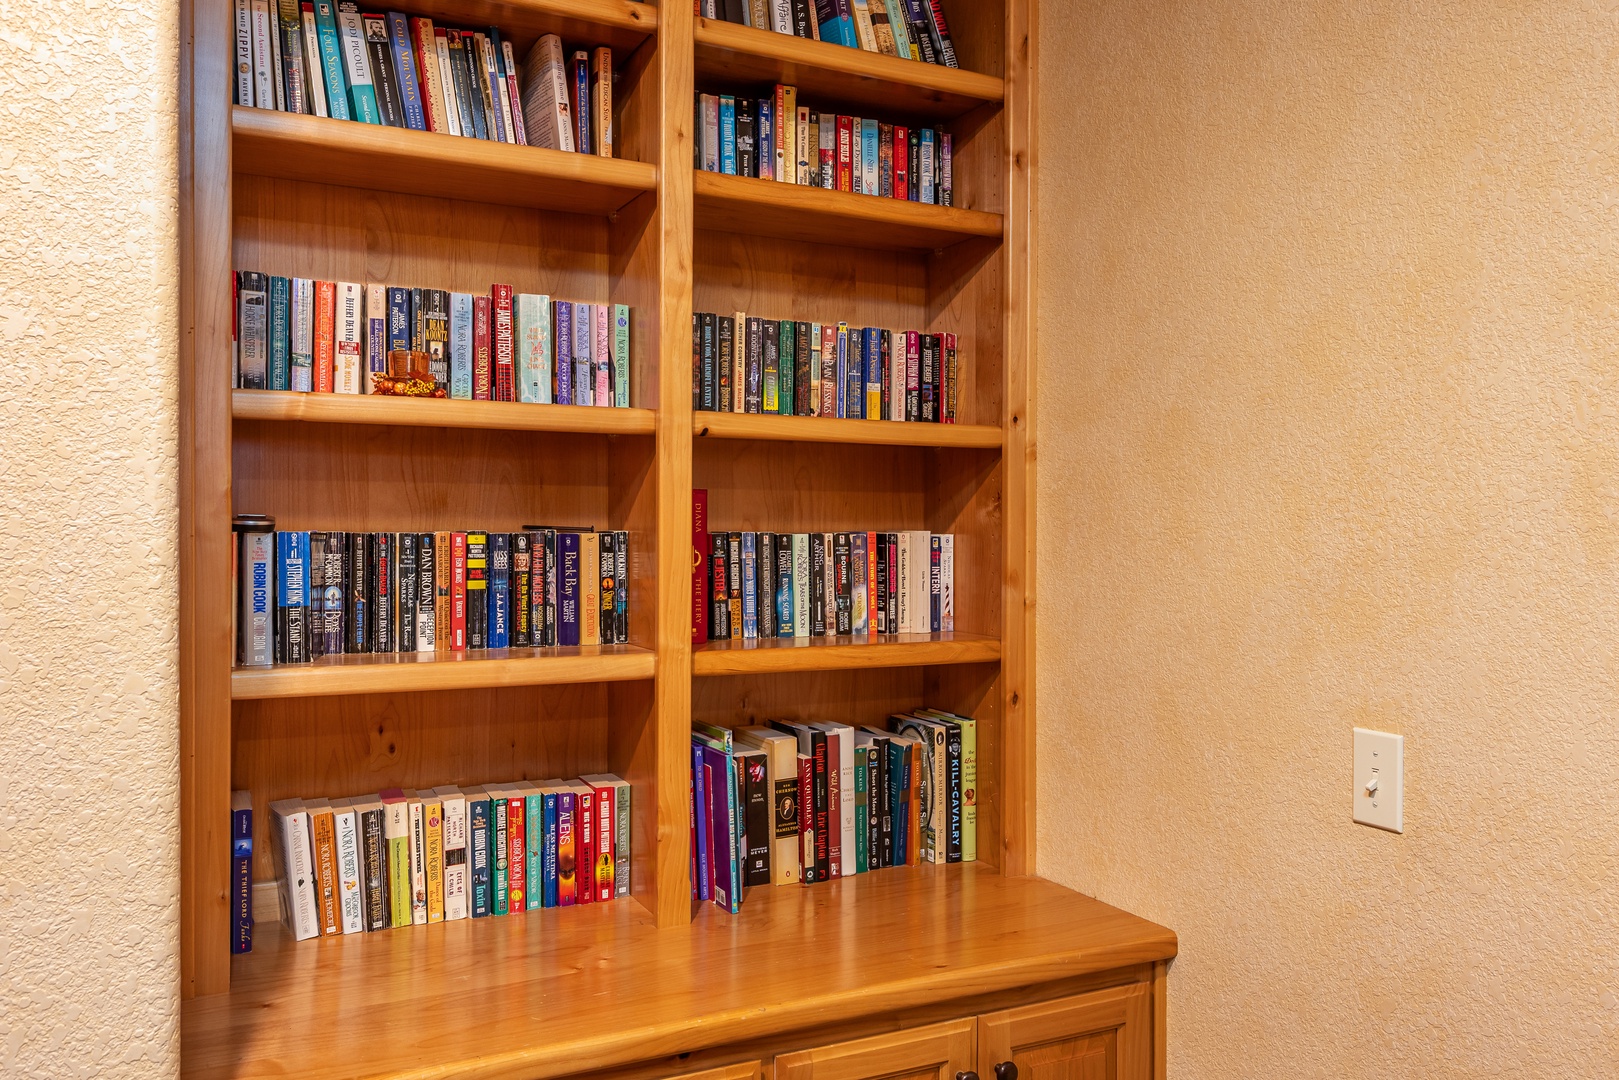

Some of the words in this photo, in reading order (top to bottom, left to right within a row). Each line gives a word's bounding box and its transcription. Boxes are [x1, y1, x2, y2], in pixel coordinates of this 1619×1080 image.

[257, 13, 266, 36] Second
[933, 12, 948, 35] WOLF
[239, 29, 248, 59] ZIPPY
[323, 29, 334, 54] FOUR
[346, 17, 357, 38] JODI
[352, 40, 365, 78] PICOULT
[395, 19, 405, 47] COLD
[400, 50, 415, 102] MOUNTAIN
[327, 55, 339, 93] SEASONS
[724, 124, 732, 141] ROBIN
[840, 129, 849, 143] ANN
[724, 142, 732, 156] COOK
[841, 144, 849, 162] RULE
[245, 306, 255, 325] HORSE
[429, 320, 446, 329] DEAN
[497, 308, 511, 329] JAMES
[245, 326, 255, 358] WHISPERER
[426, 330, 448, 341] KOONTZ
[458, 323, 468, 342] NORA
[498, 329, 511, 364] PATTERSON
[924, 348, 932, 366] JEFFERY
[456, 344, 466, 371] ROBERTS
[476, 347, 488, 374] ROBERTS
[616, 356, 626, 378] ROBERTS
[908, 359, 918, 376] STEPHEN
[824, 360, 833, 378] PLAIN
[476, 375, 488, 394] NORA
[908, 377, 918, 388] KING
[824, 382, 834, 413] BLESSINGS
[422, 549, 432, 569] DAN
[532, 544, 543, 558] RUN
[731, 541, 739, 563] MICHAEL
[532, 558, 543, 574] THEY
[564, 551, 577, 576] Back
[253, 562, 266, 588] ROBIN
[287, 565, 302, 589] STEPHEN
[532, 576, 543, 591] HOW
[714, 566, 724, 591] JESTER
[731, 564, 739, 589] CRICHTON
[287, 590, 302, 604] KING
[422, 572, 432, 604] BROWN
[561, 577, 576, 596] Bay
[253, 590, 266, 613] COOK
[532, 592, 543, 605] SEE
[586, 594, 595, 607] GREAT
[603, 590, 614, 610] STINGER
[289, 608, 301, 620] THE
[586, 609, 595, 637] EXPECTATIONS
[289, 621, 301, 643] STAND
[813, 743, 826, 773] Clapton
[601, 801, 609, 818] RICHARD
[951, 759, 960, 846] KILL-CAVALRY
[497, 806, 505, 830] MICHAEL
[559, 812, 570, 845] ALIENS
[601, 818, 609, 831] NORTH
[817, 812, 826, 828] Eric
[293, 830, 303, 849] CARNAL
[342, 830, 353, 850] NORA
[429, 839, 439, 855] NORA
[474, 830, 485, 850] ROBIN
[497, 830, 505, 859] CRICHTON
[512, 838, 524, 862] ROBERTS
[601, 832, 609, 853] PATTERSON
[815, 829, 827, 859] Clapton
[295, 850, 304, 875] INNOCENCE
[320, 844, 329, 861] NORA
[475, 851, 486, 869] COOK
[322, 862, 331, 886] ROBERTS
[343, 851, 356, 878] ROBERTS
[428, 857, 440, 882] ROBERTS
[513, 863, 522, 880] NORA
[476, 884, 485, 907] Toxin
